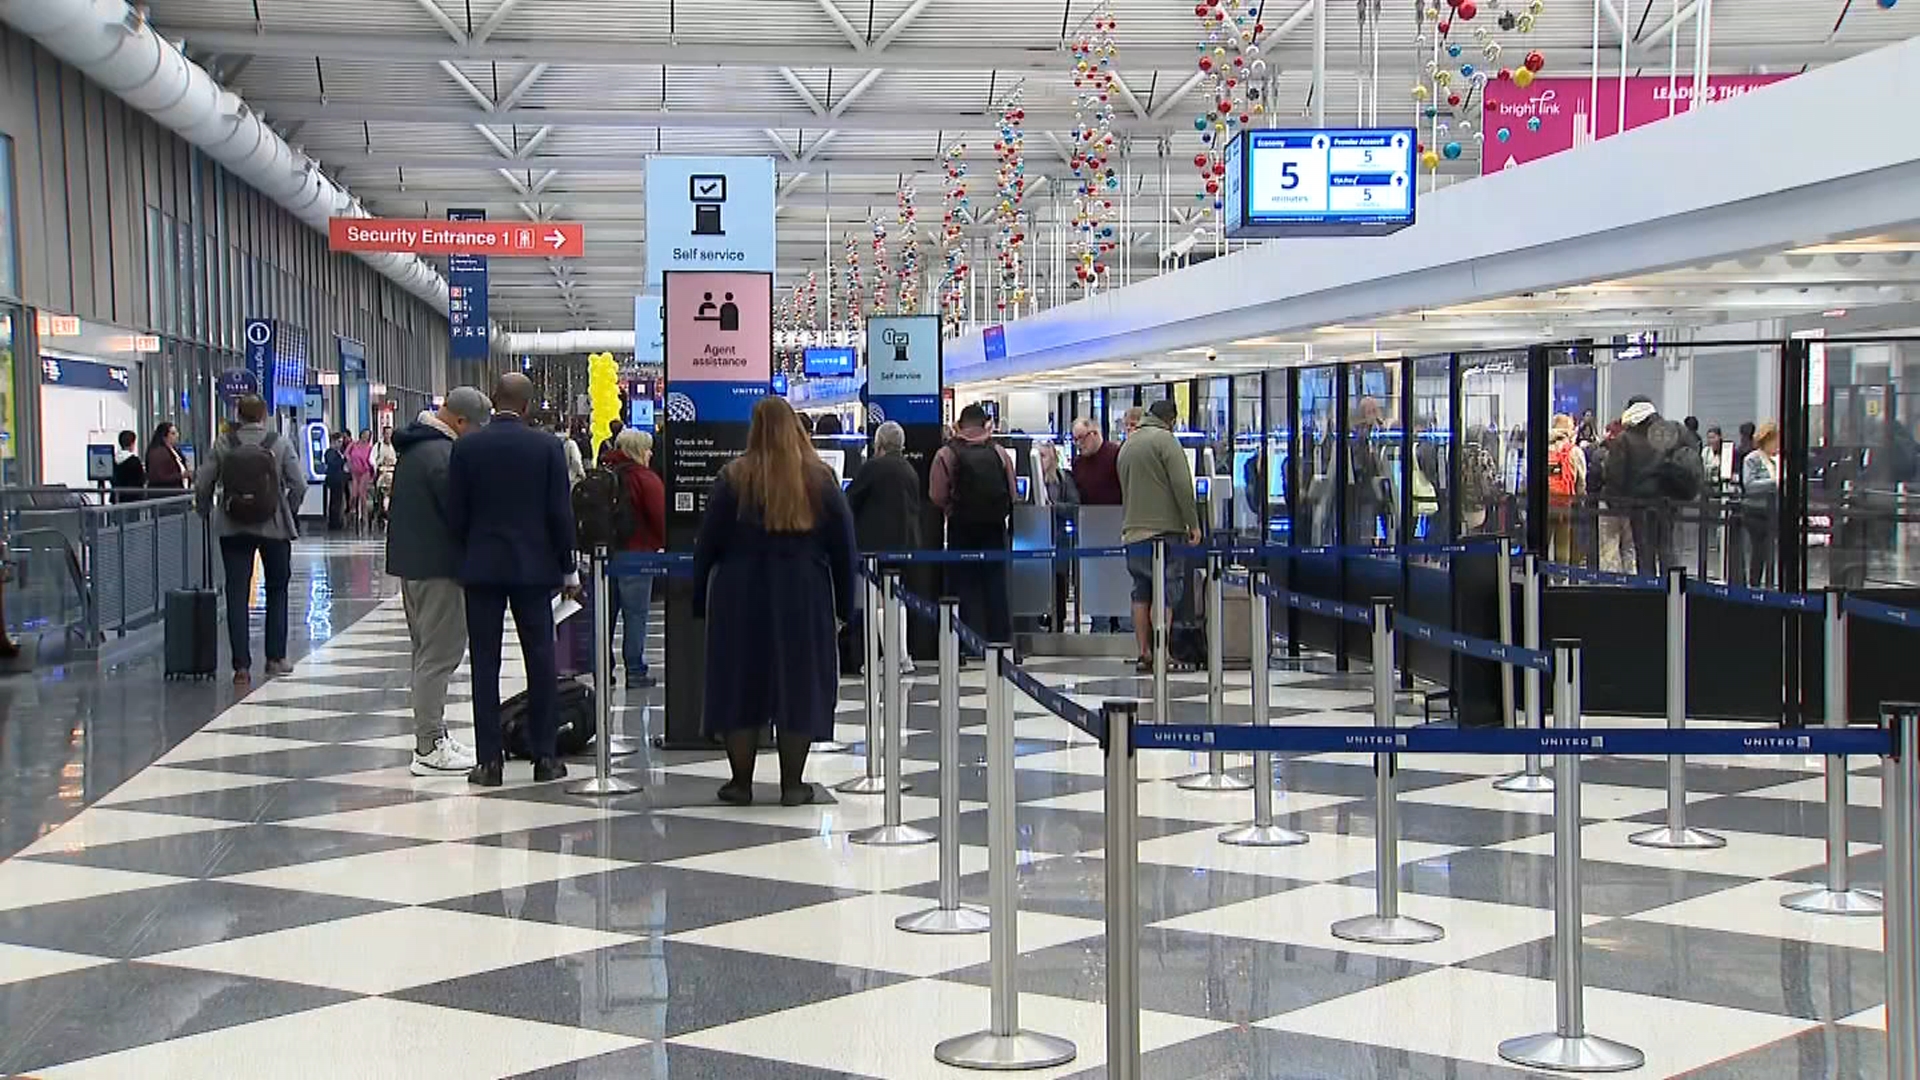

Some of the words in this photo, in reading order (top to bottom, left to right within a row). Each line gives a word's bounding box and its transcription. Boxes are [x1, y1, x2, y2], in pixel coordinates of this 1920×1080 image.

[1653, 86, 1716, 100] LEADIG
[1257, 138, 1287, 148] Economy
[1364, 150, 1373, 163] 5
[1281, 161, 1300, 190] 5
[1363, 188, 1372, 201] 5
[347, 226, 417, 247] Security
[422, 229, 496, 246] Entrance
[501, 231, 509, 246] 1
[672, 247, 698, 261] Self
[700, 248, 745, 261] service
[55, 317, 77, 333] EXIT
[138, 337, 157, 347] EXIT
[704, 344, 736, 356] Agent
[692, 356, 748, 367] assistance
[881, 371, 894, 380] Self
[895, 371, 921, 380] service
[732, 387, 765, 395] UNITED
[1154, 732, 1201, 742] UNITED
[1345, 735, 1393, 744] UNITED
[1541, 737, 1589, 746] UNITED
[1743, 737, 1795, 747] UNITED
